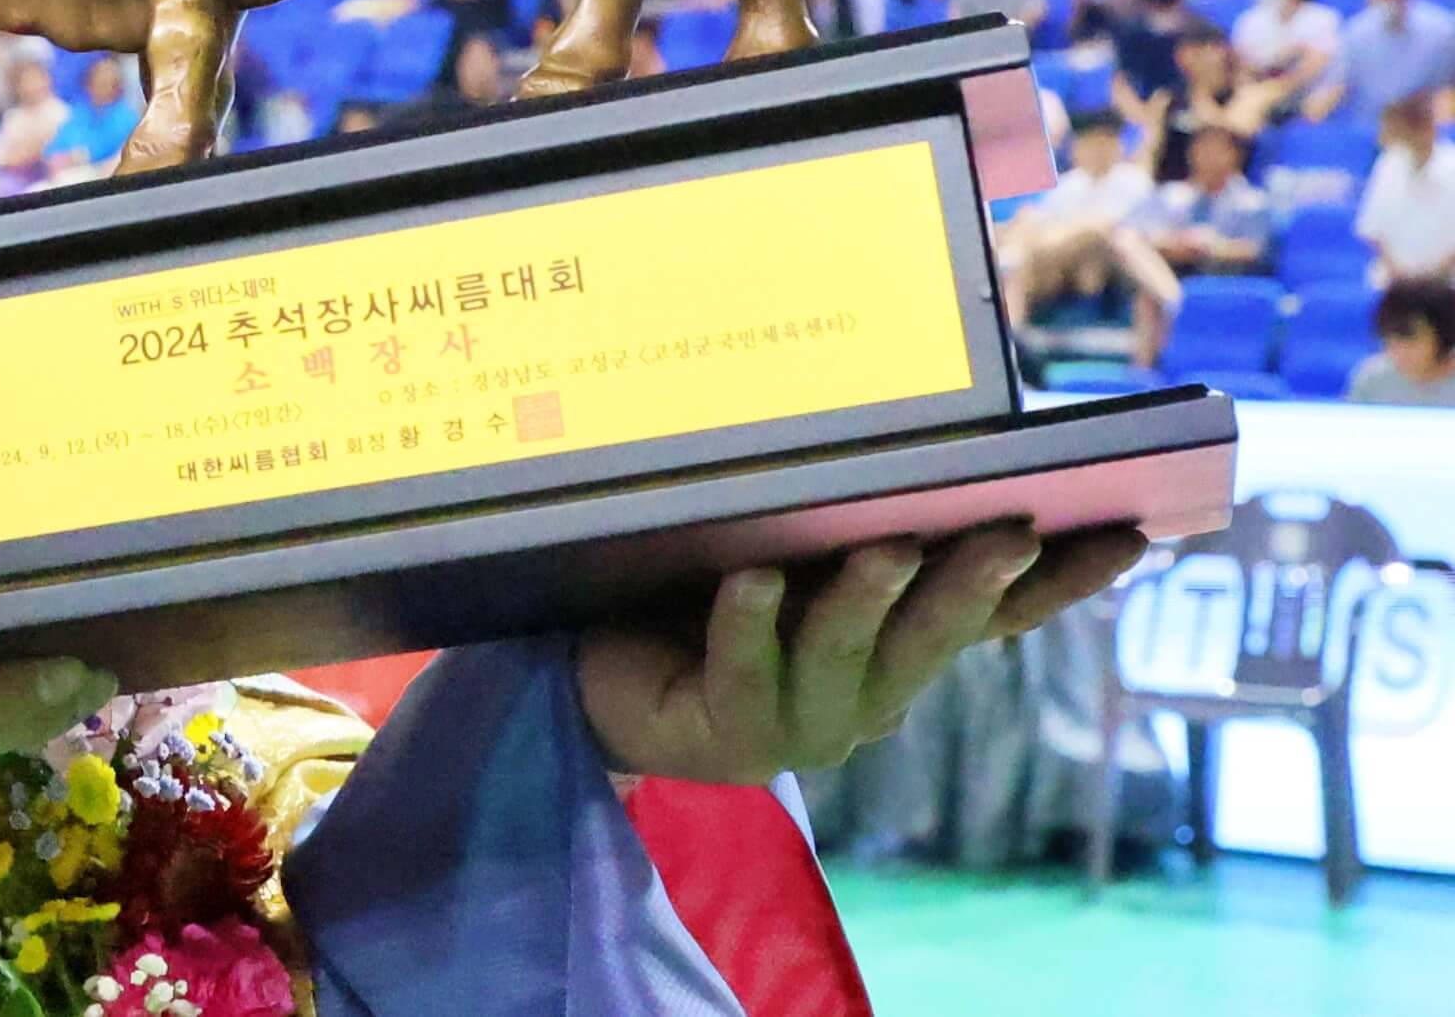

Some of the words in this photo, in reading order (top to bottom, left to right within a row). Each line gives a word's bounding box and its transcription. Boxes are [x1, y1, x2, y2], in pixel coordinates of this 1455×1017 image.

[119, 322, 209, 365] 2024
[227, 256, 586, 348] 추석장사씨름대회
[190, 276, 277, 308] 위더스제약
[177, 440, 328, 483] 대한씨름협회
